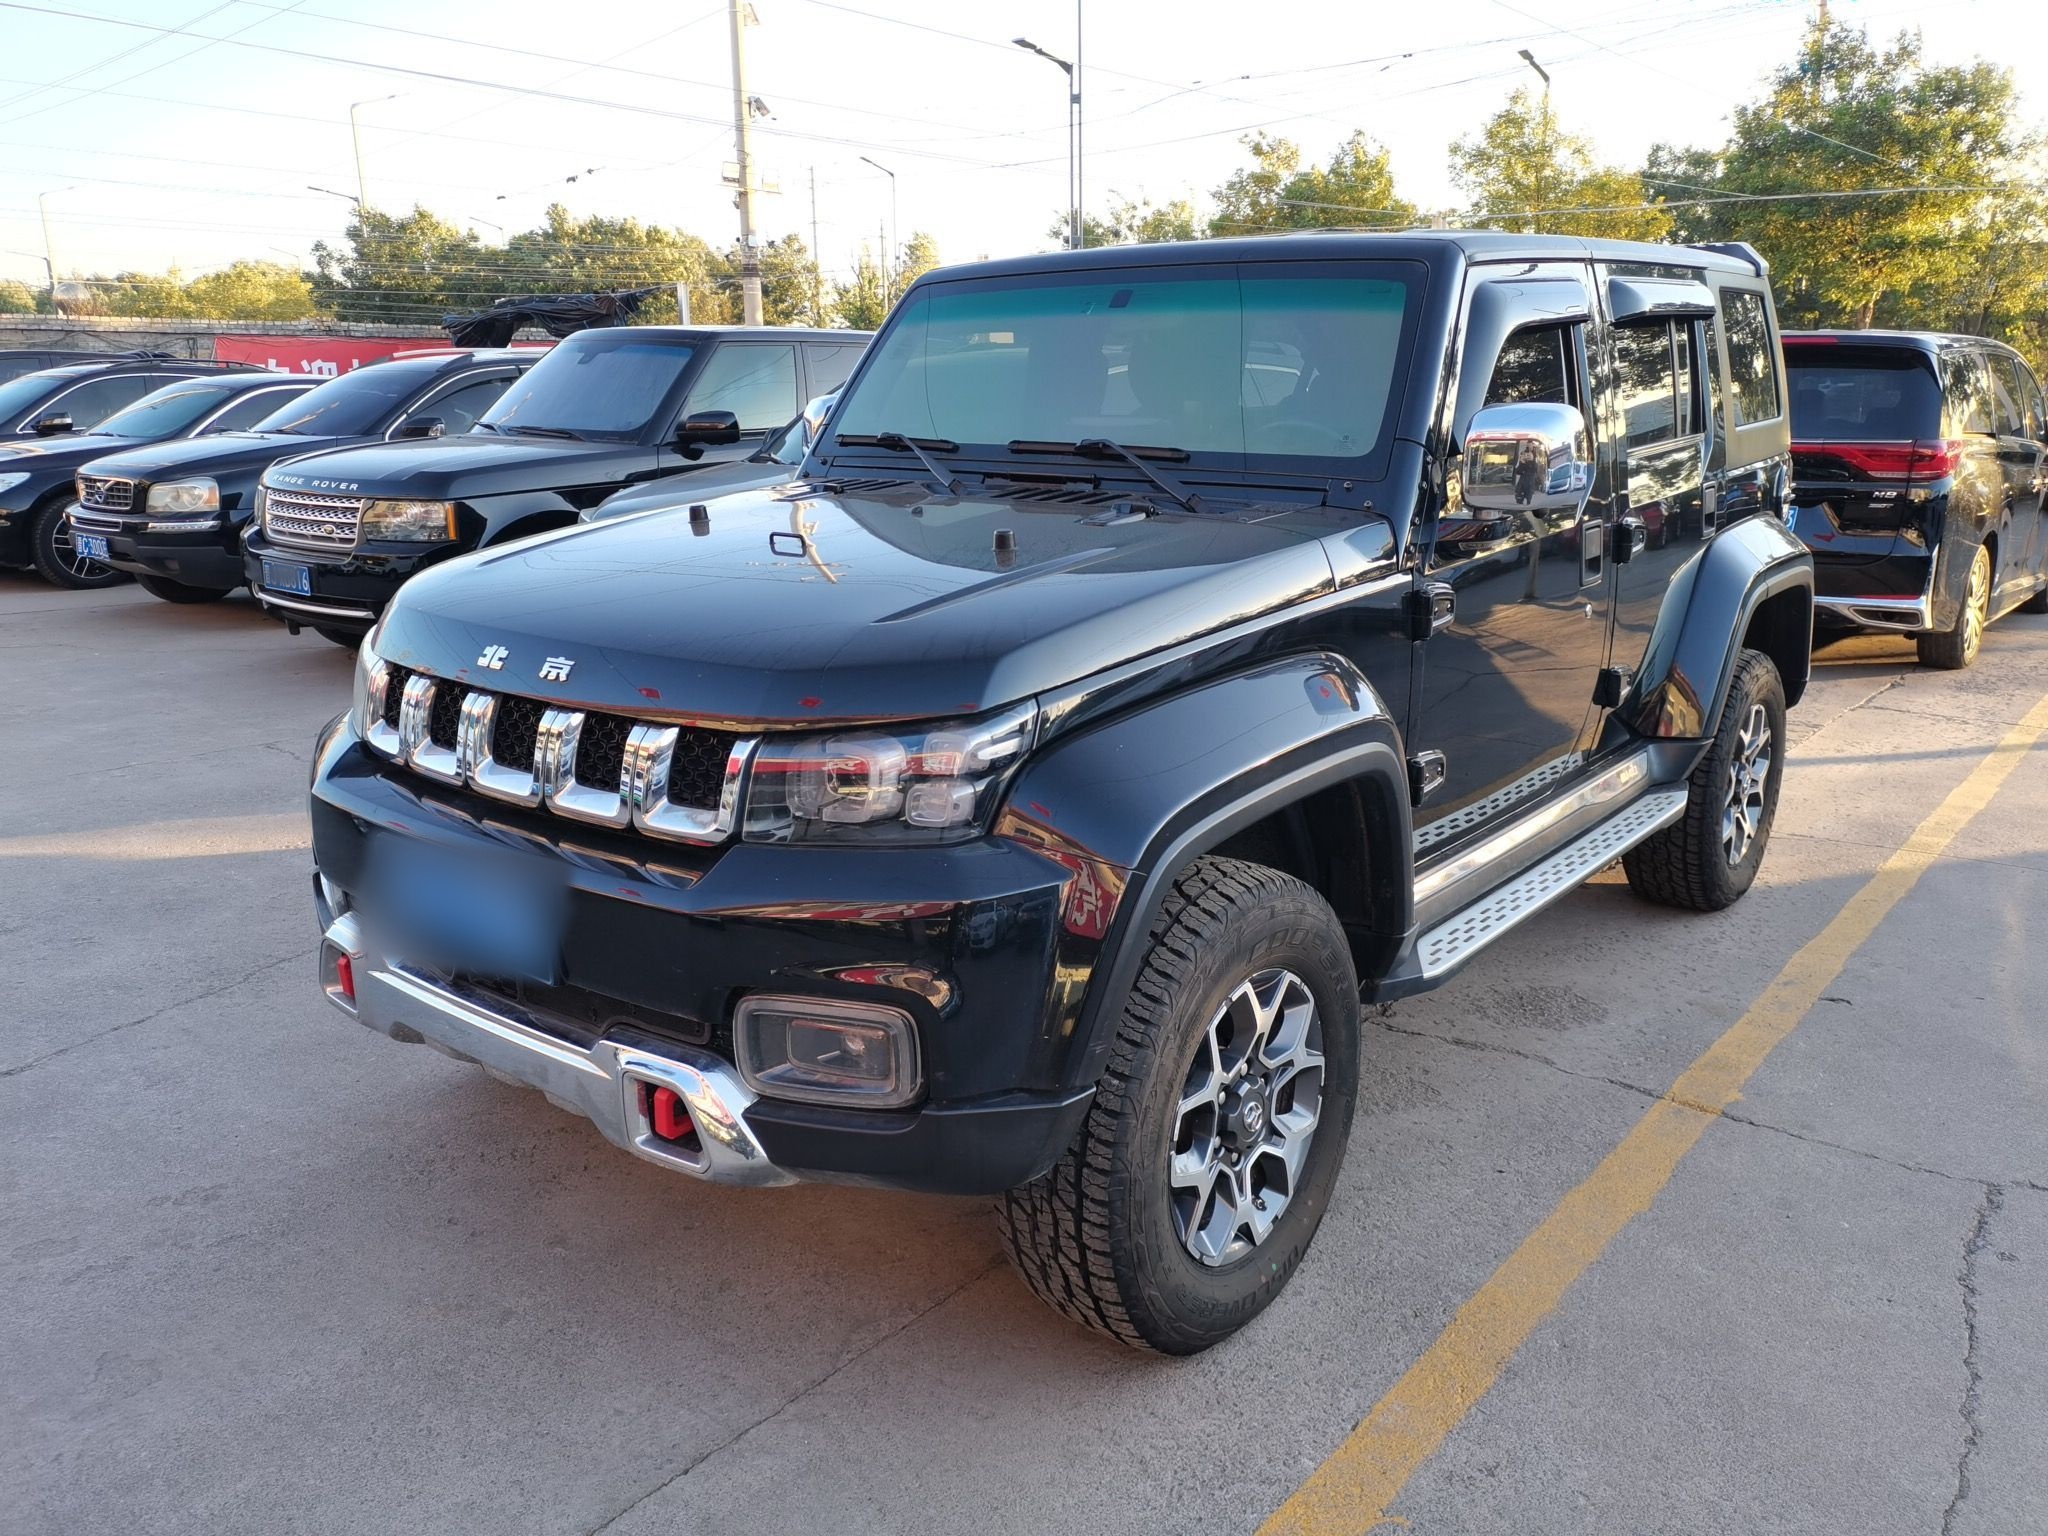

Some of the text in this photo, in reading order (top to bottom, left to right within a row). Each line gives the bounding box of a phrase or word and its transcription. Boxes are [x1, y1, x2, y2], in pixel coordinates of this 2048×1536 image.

[272, 474, 359, 491] RANGE ROVER
[476, 644, 577, 682] 北京
